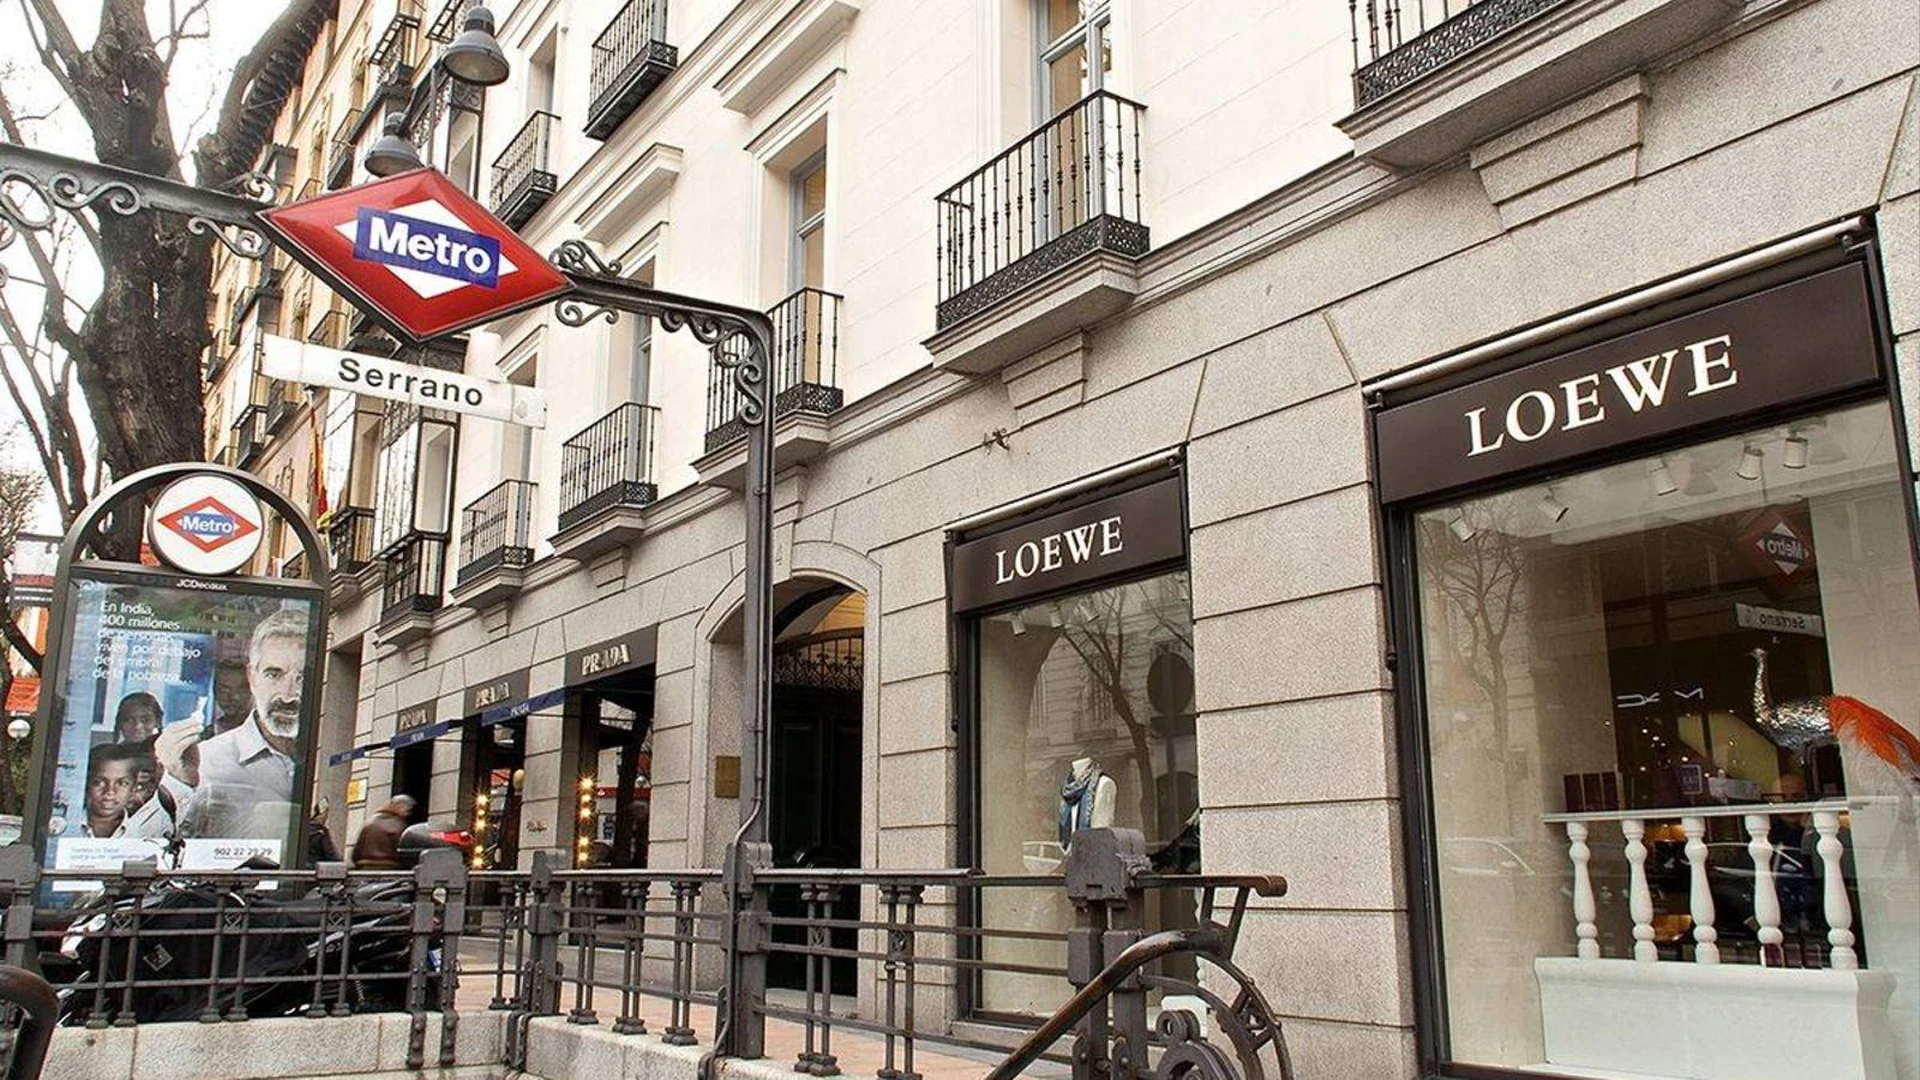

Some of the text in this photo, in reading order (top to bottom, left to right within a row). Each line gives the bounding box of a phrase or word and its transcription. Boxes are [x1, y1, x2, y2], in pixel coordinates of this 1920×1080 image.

[369, 216, 492, 274] Metro
[338, 357, 483, 406] Serrano
[1464, 334, 1738, 457] LOEWE
[182, 515, 233, 533] Metro
[995, 515, 1123, 585] LOEWE
[176, 579, 229, 592] JCDecaux
[101, 601, 155, 617] En India,
[128, 617, 181, 630] millones
[581, 644, 630, 676] PRADA
[214, 847, 231, 857] 902
[232, 847, 245, 856] 22
